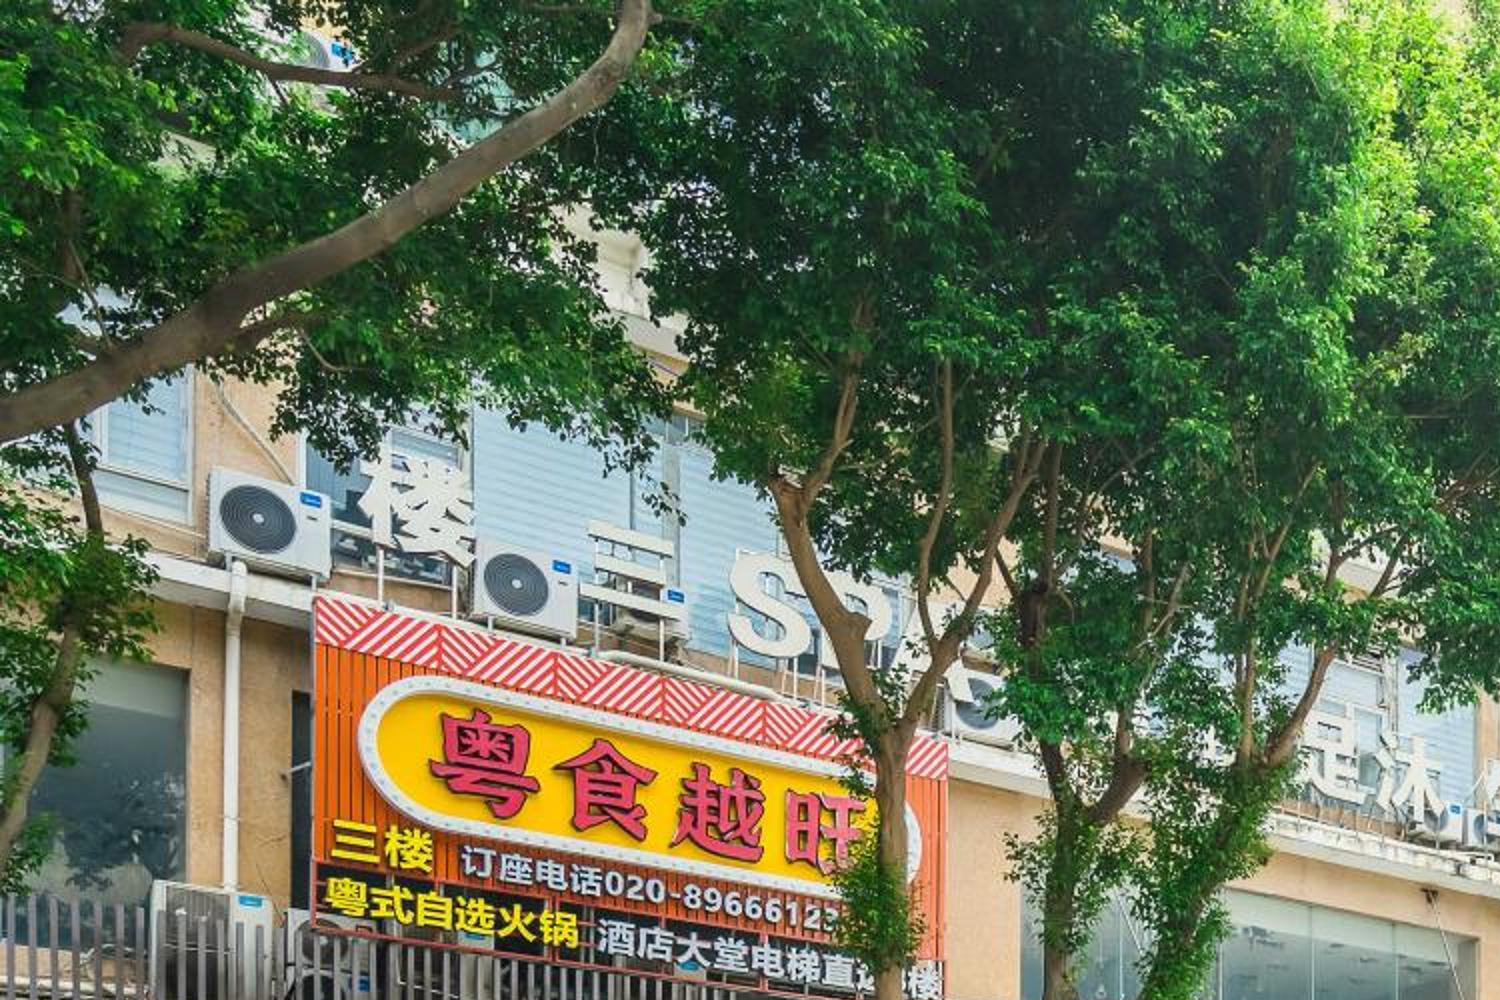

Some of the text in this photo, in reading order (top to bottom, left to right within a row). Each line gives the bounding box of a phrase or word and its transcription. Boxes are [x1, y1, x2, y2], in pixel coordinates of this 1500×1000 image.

[428, 706, 866, 876] 粤食越旺
[331, 819, 433, 875] 三楼
[325, 876, 579, 949] 粤式自选火锅
[598, 917, 944, 1000] 酒店大堂电梯直达楼
